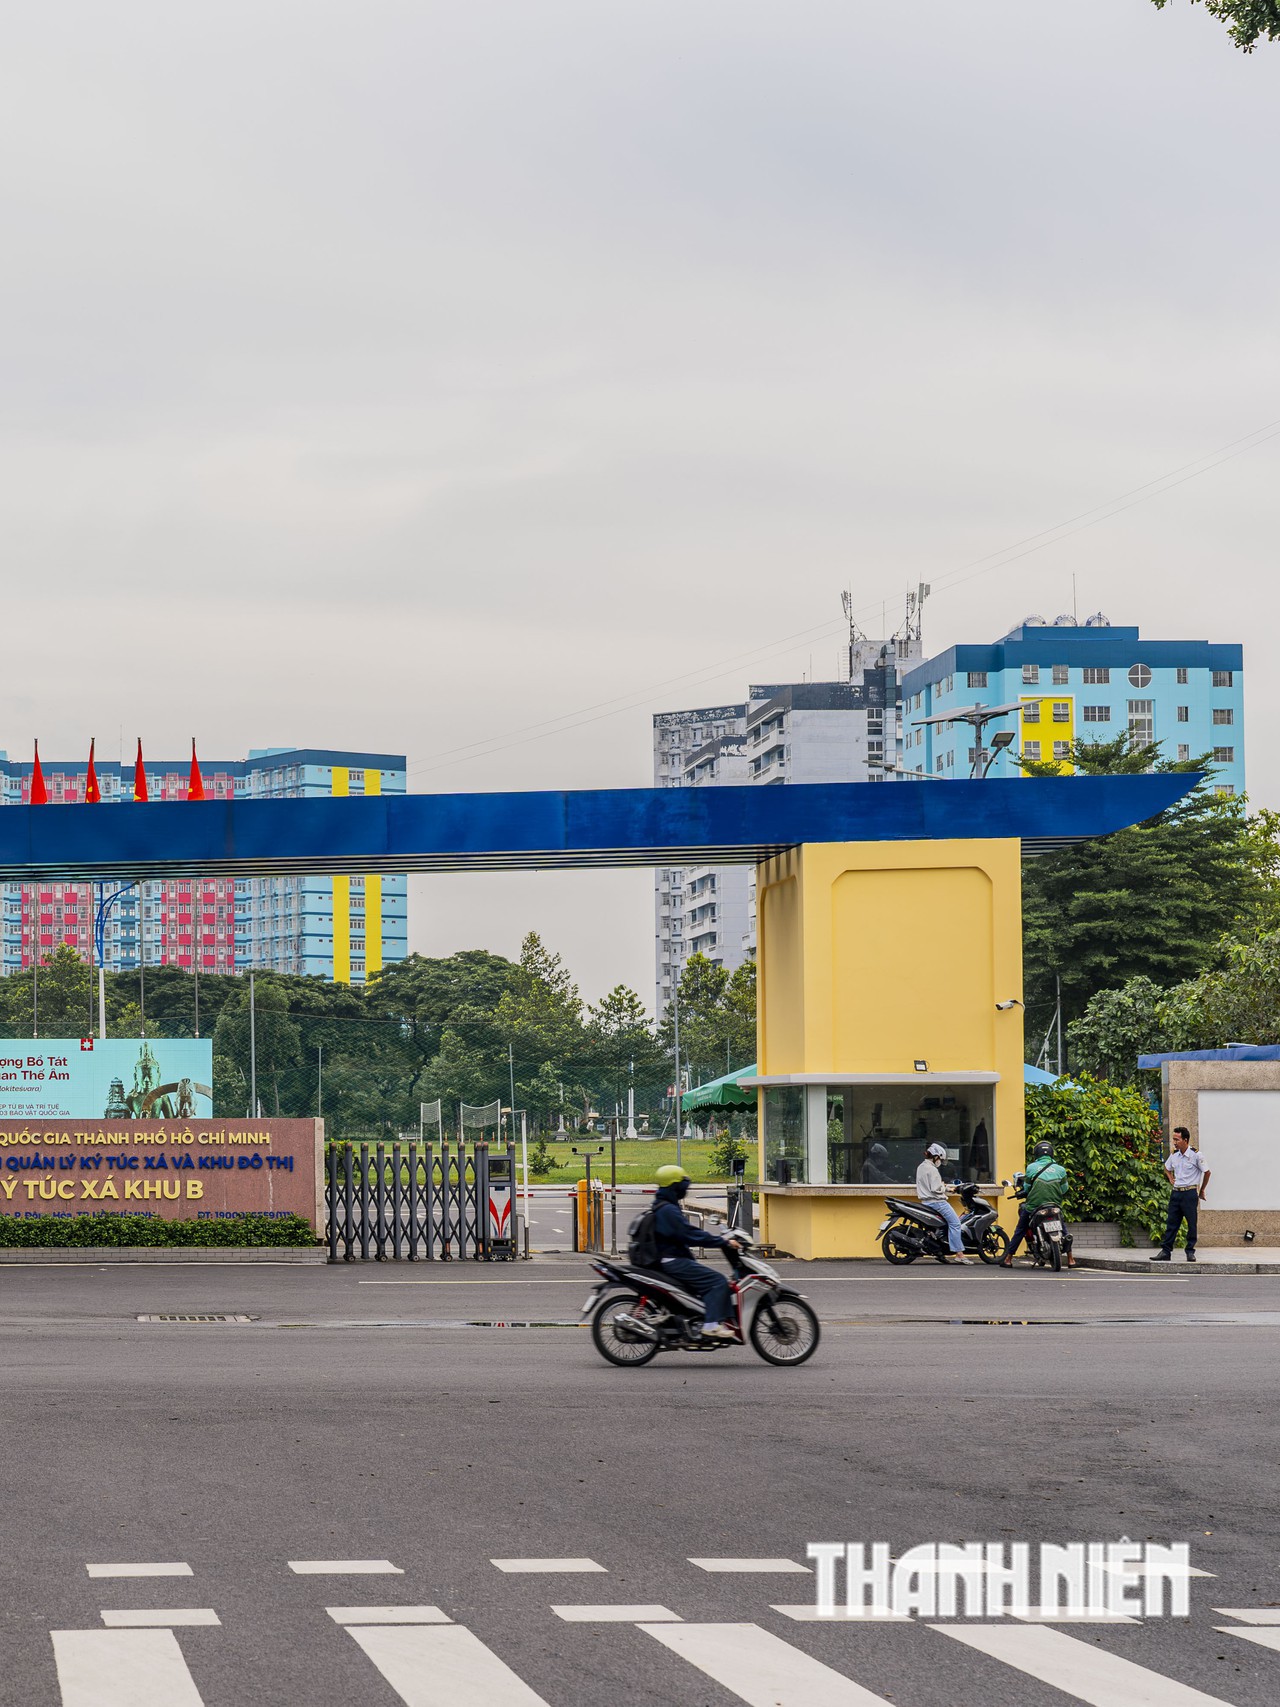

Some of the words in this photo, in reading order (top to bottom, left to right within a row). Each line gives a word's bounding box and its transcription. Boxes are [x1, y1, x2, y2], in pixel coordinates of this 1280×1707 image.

[47, 1056, 68, 1067] Tát
[21, 1068, 45, 1080] Thế
[49, 1068, 70, 1080] Âm
[43, 1132, 71, 1146] GIA
[74, 1129, 129, 1145] THÀNH
[134, 1127, 167, 1145] PHỐ
[170, 1127, 194, 1145] HỒ
[197, 1129, 225, 1145] CHÍ
[228, 1132, 270, 1145] MINH
[5, 1152, 55, 1172] QUẢN
[59, 1153, 77, 1170] LÝ
[80, 1153, 102, 1170] KÝ
[105, 1153, 139, 1170] TÚC
[144, 1153, 168, 1170] XÁ
[171, 1153, 195, 1170] VÀ
[198, 1156, 234, 1170] KHU
[237, 1153, 263, 1170] ĐÔ
[266, 1156, 294, 1172] THỊ
[23, 1175, 75, 1200] TÚC
[80, 1175, 119, 1200] XÁ
[124, 1180, 180, 1200] KHU
[186, 1180, 204, 1200] B
